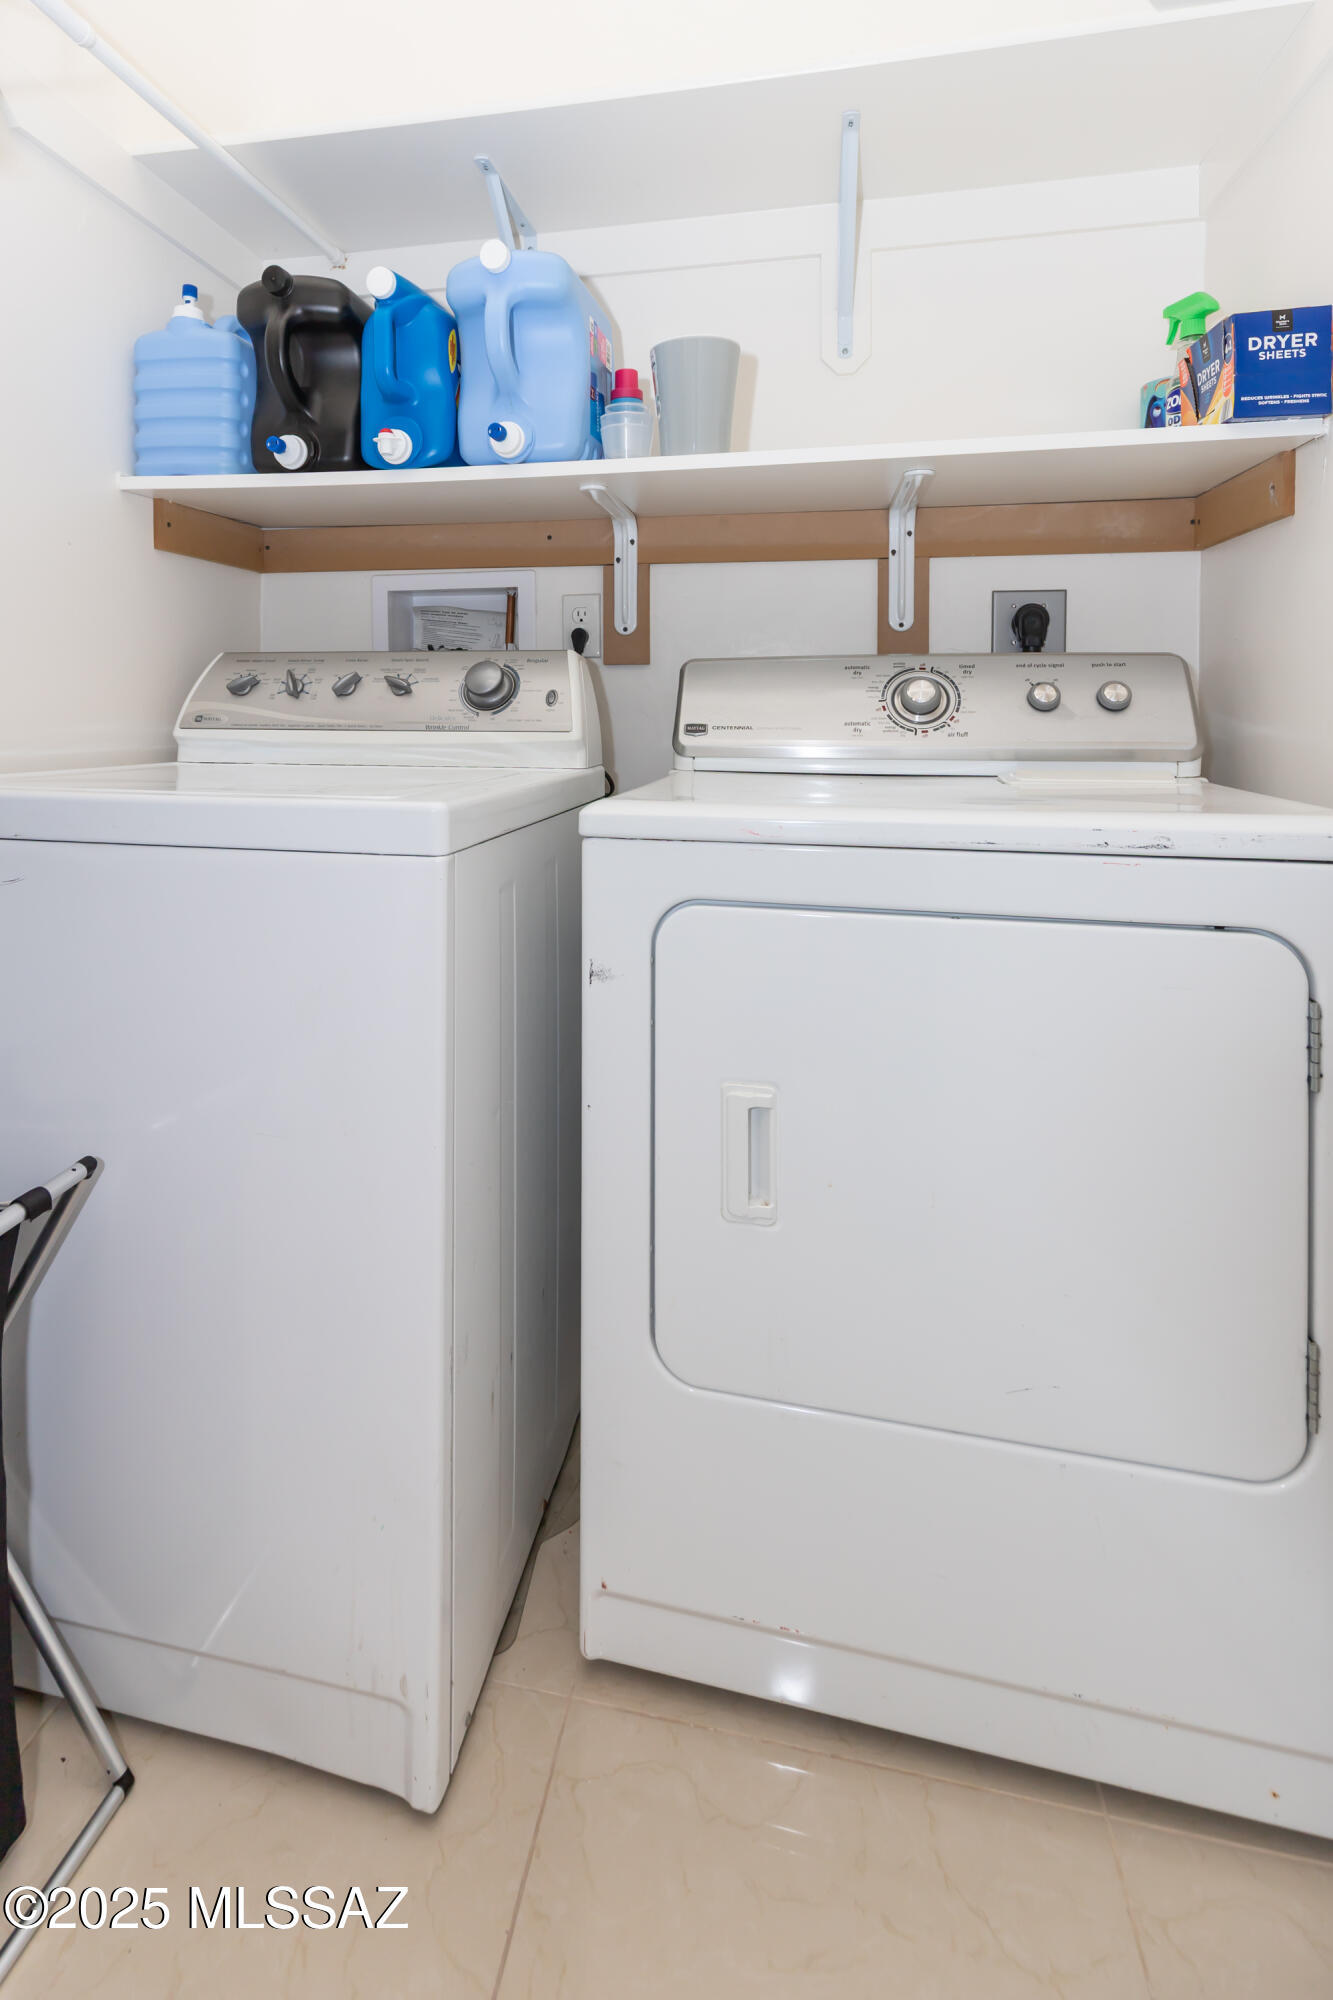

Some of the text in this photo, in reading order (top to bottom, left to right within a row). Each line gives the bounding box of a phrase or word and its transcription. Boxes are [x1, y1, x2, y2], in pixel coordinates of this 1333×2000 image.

[1248, 332, 1318, 351] DRYER
[1258, 348, 1306, 360] SHEETS
[1197, 359, 1220, 386] DRYER
[1201, 376, 1217, 393] SHEETS
